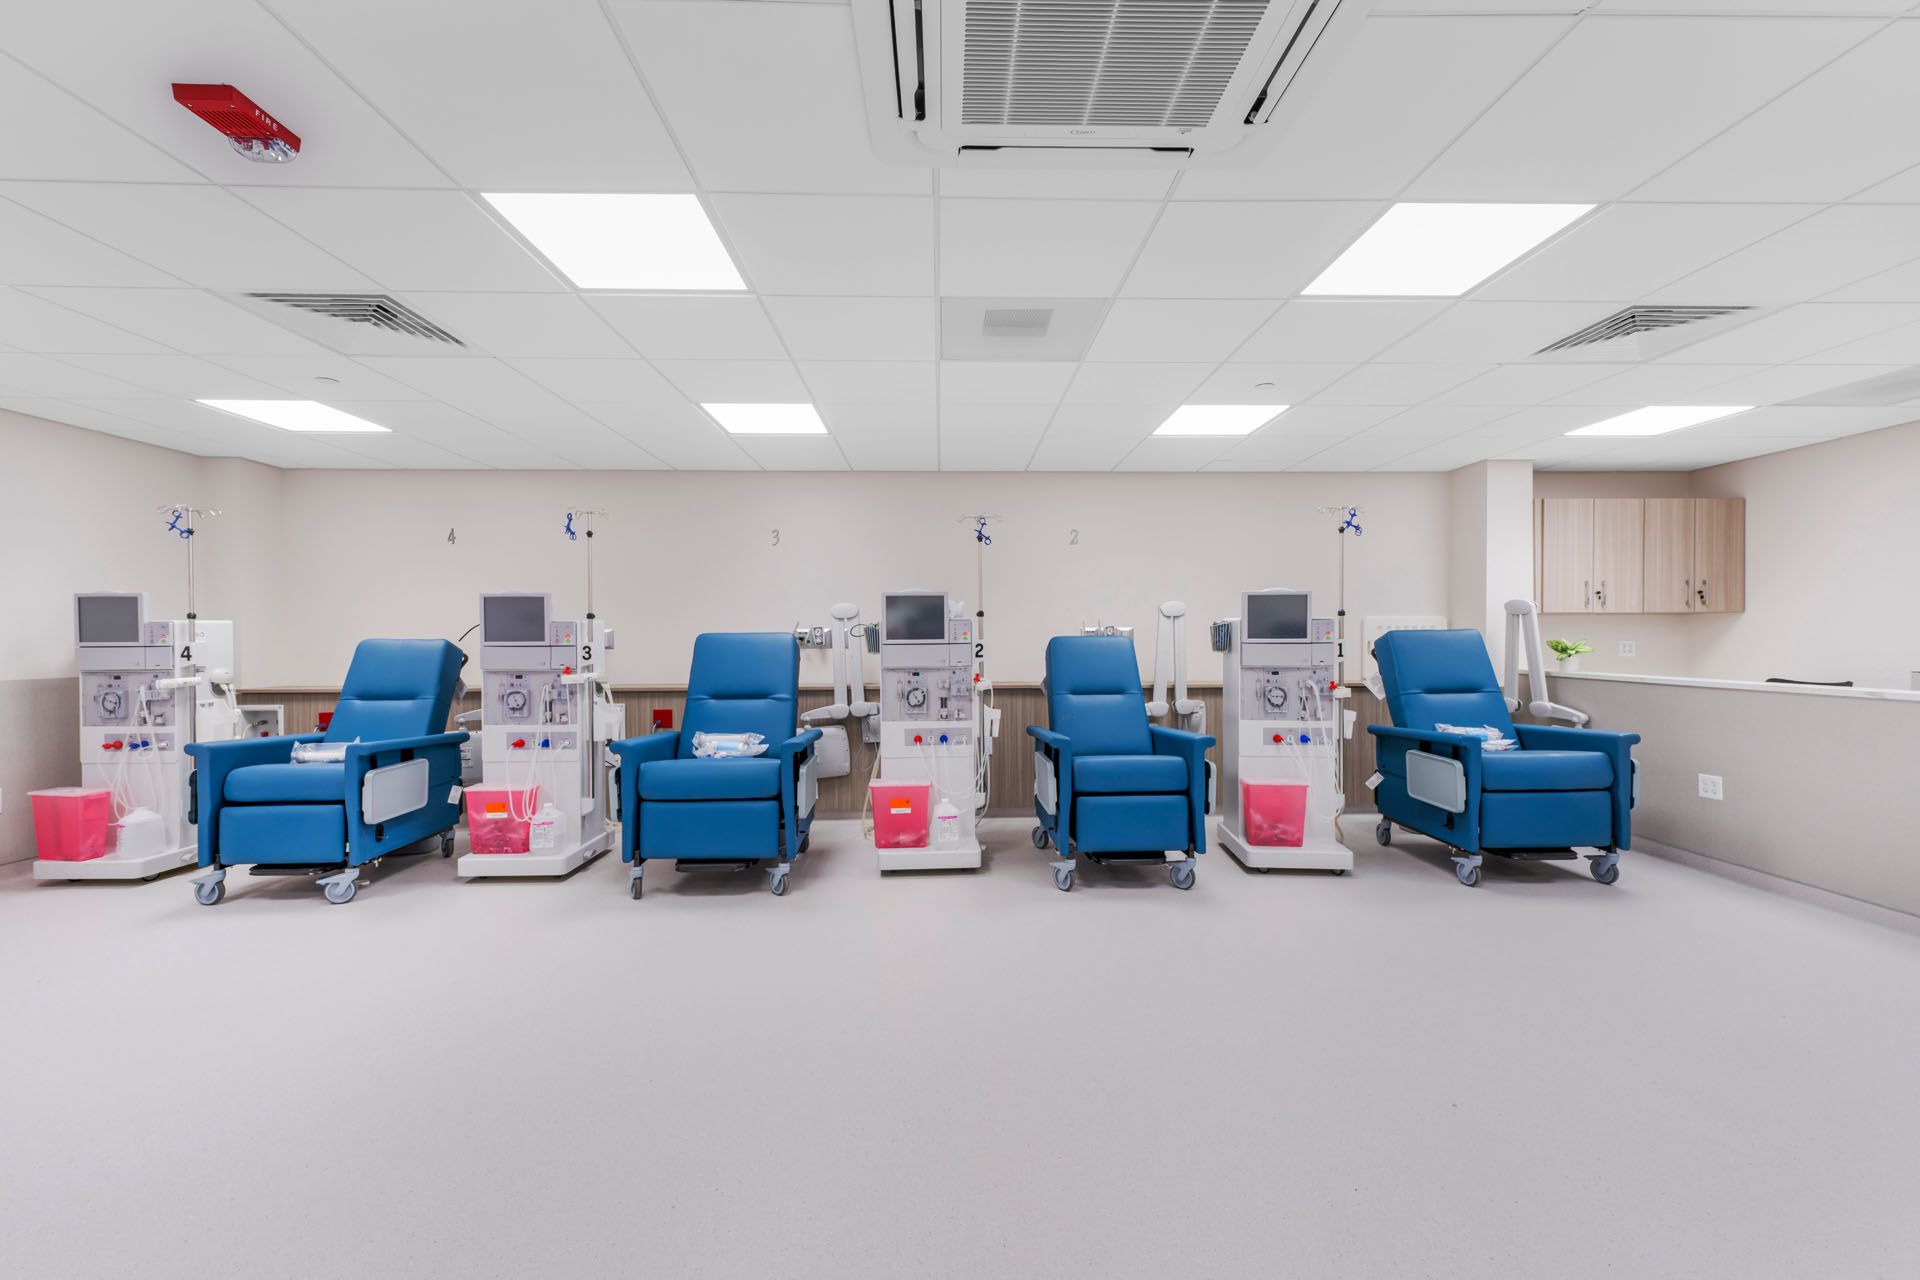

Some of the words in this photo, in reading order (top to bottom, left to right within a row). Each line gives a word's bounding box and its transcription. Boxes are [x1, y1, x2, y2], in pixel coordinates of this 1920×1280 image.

[255, 109, 278, 132] FIRE
[448, 528, 456, 545] 4
[771, 529, 780, 546] 3
[1070, 529, 1080, 546] 2
[180, 645, 192, 661] 4
[582, 645, 592, 661] 3
[975, 643, 984, 658] 2
[1337, 642, 1344, 658] 1
